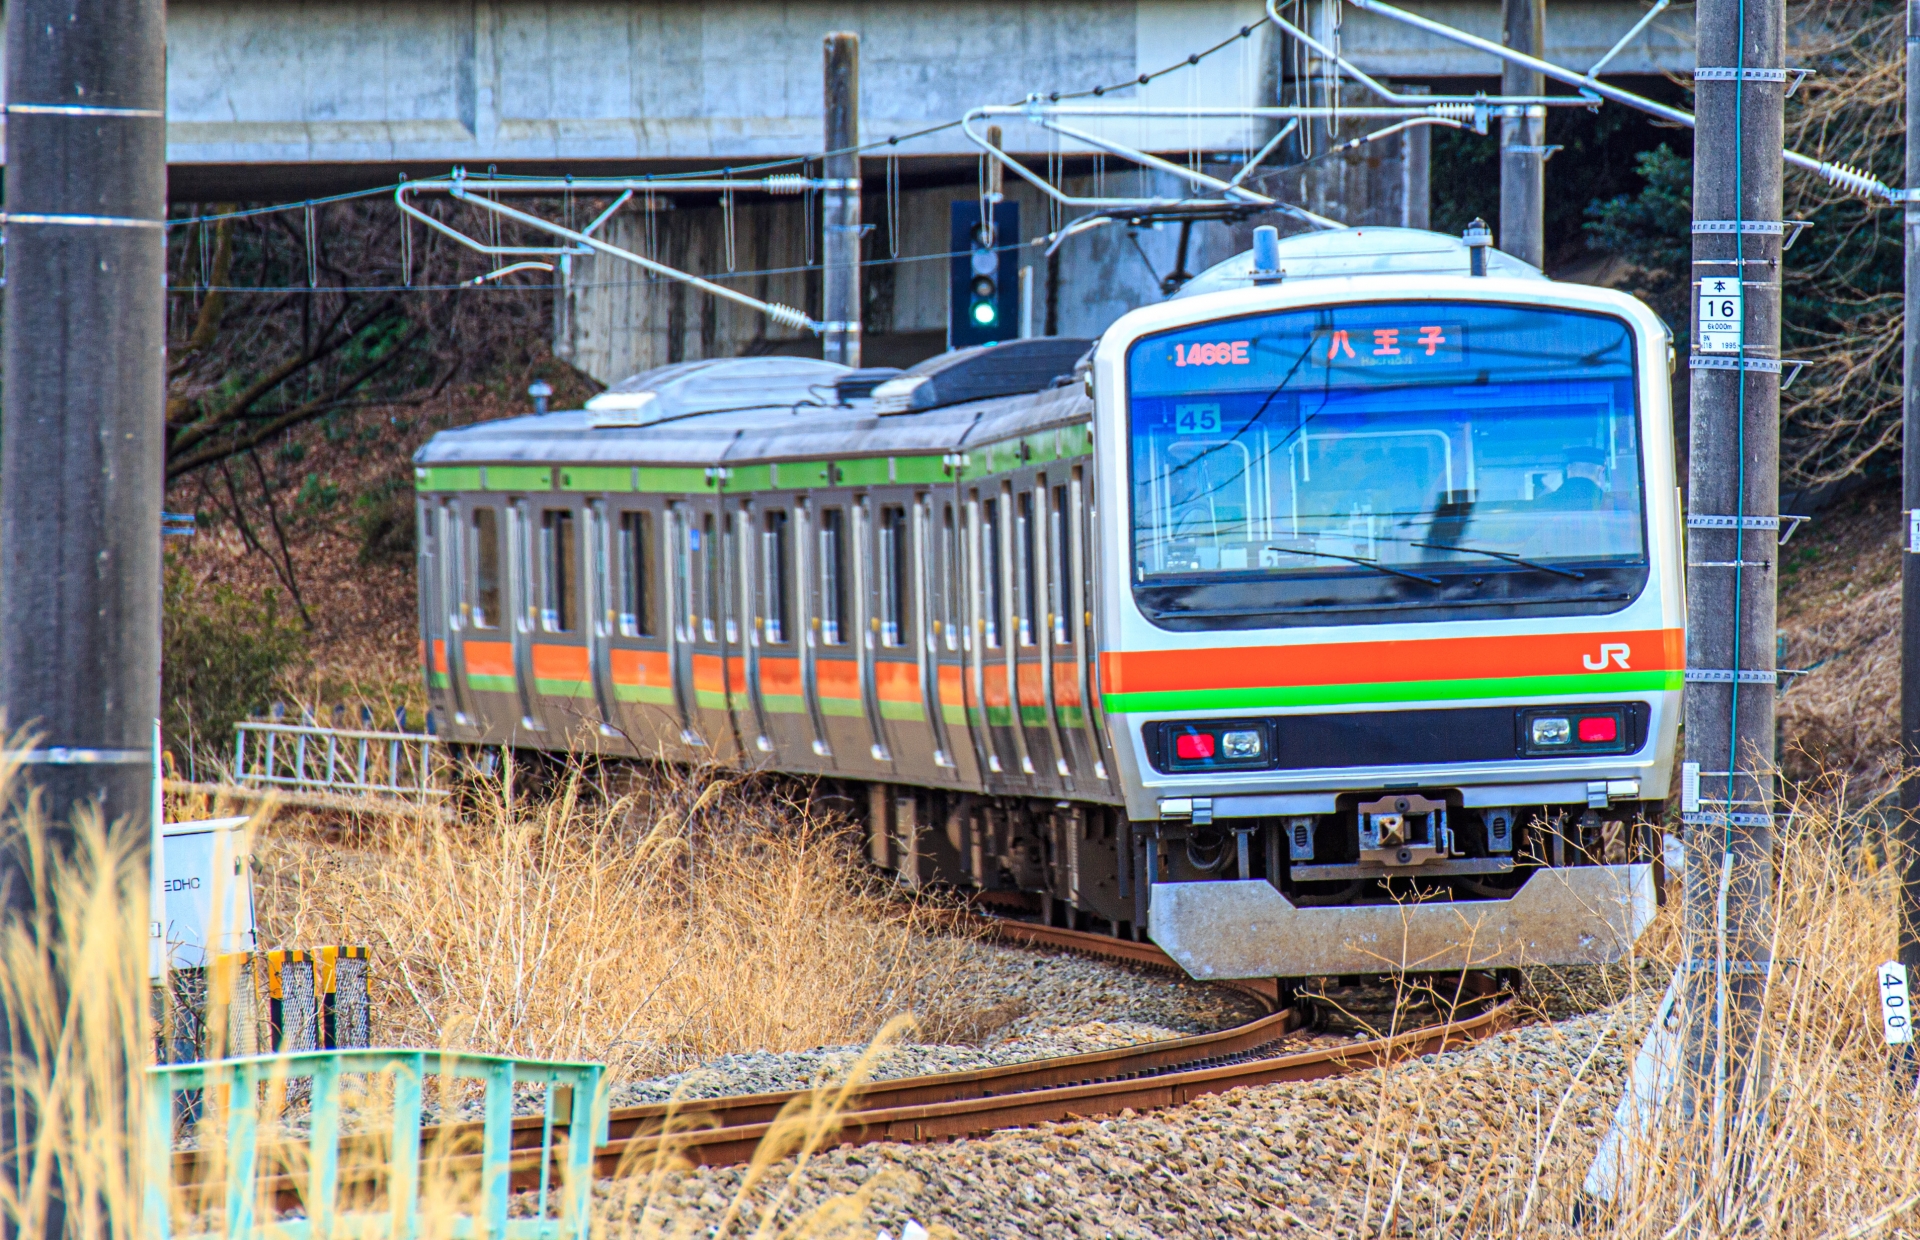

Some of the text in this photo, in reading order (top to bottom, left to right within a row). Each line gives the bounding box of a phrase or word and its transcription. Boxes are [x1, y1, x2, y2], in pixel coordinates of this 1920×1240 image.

[1713, 280, 1726, 293] 本
[1708, 300, 1734, 317] 16
[1175, 340, 1250, 367] 1466E
[1328, 326, 1446, 360] 八王子
[1180, 410, 1216, 430] 45
[1583, 643, 1631, 670] JR
[1883, 974, 1906, 1028] 400
